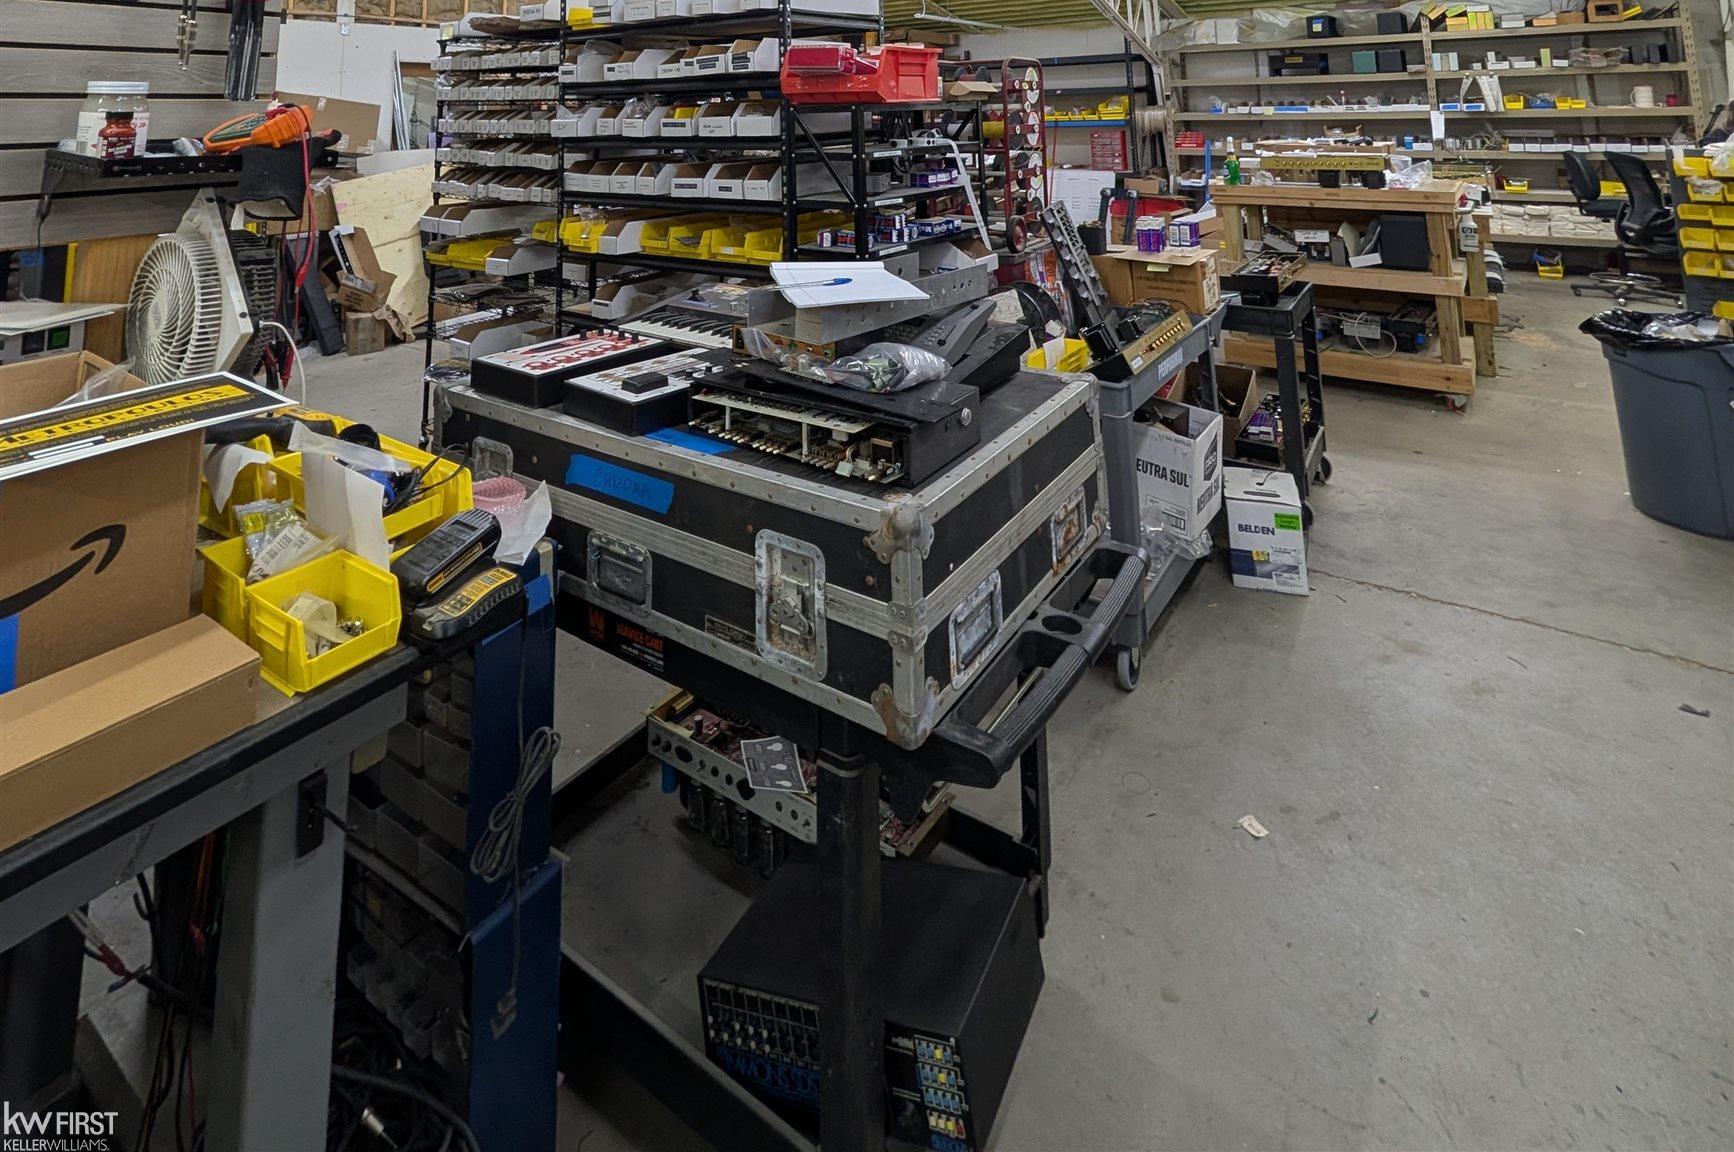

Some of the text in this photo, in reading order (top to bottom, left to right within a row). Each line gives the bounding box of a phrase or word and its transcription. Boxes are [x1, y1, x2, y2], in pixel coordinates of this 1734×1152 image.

[1136, 457, 1189, 488] EUTRA SUL
[1238, 523, 1275, 535] BELDEN
